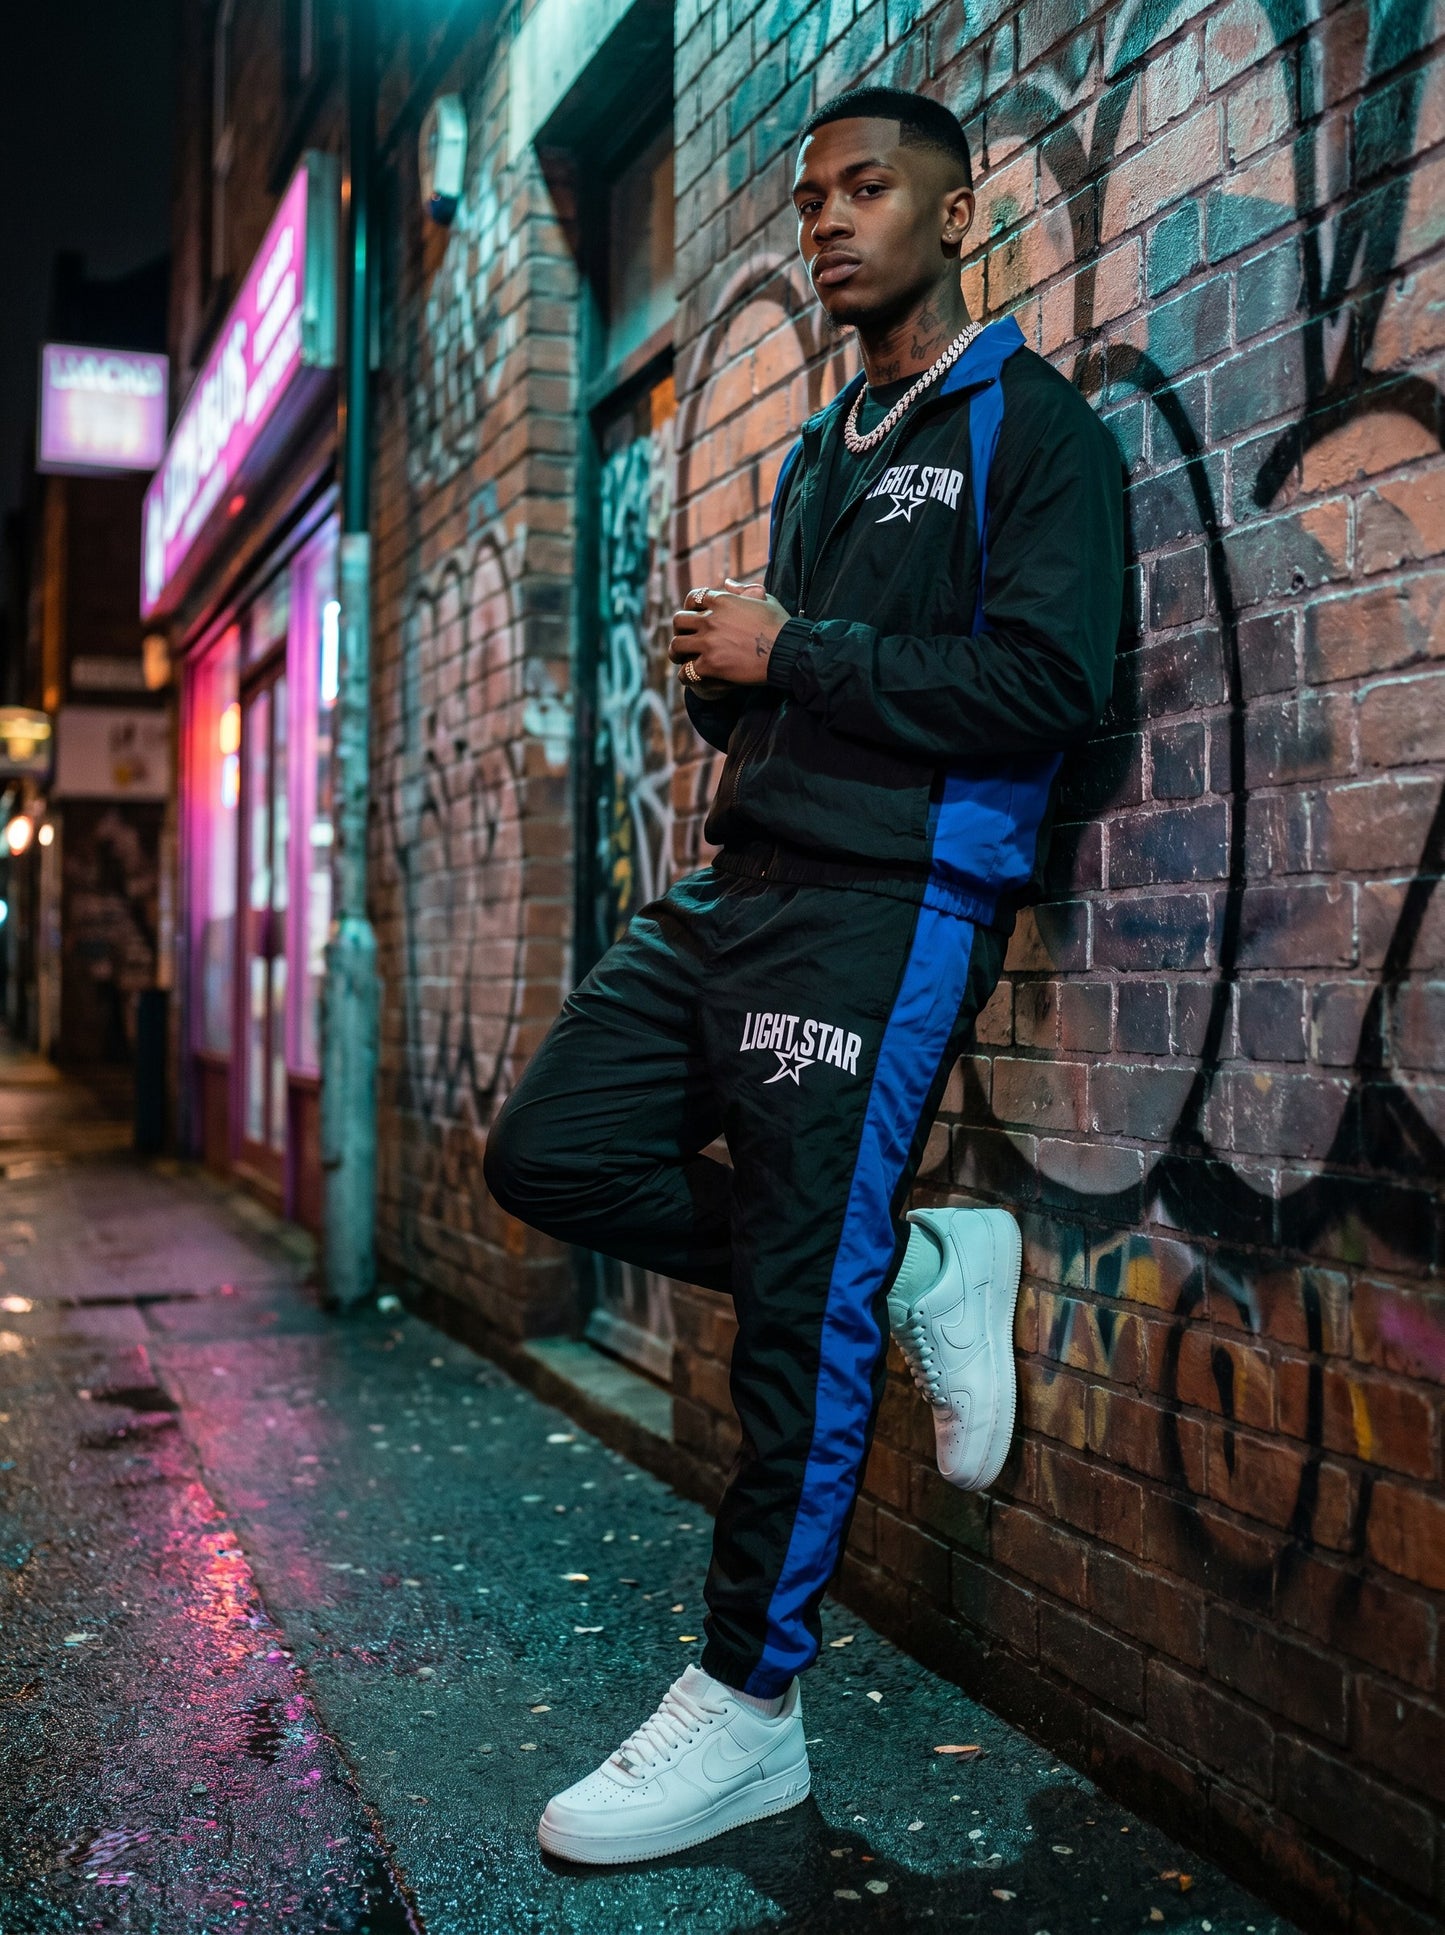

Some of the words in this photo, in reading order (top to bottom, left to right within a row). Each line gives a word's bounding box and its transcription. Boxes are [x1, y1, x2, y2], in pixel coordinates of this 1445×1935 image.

[865, 464, 919, 500] IGHT
[915, 466, 964, 511] STAR
[740, 1012, 800, 1052] LIGHT
[799, 1019, 862, 1076] STAR
